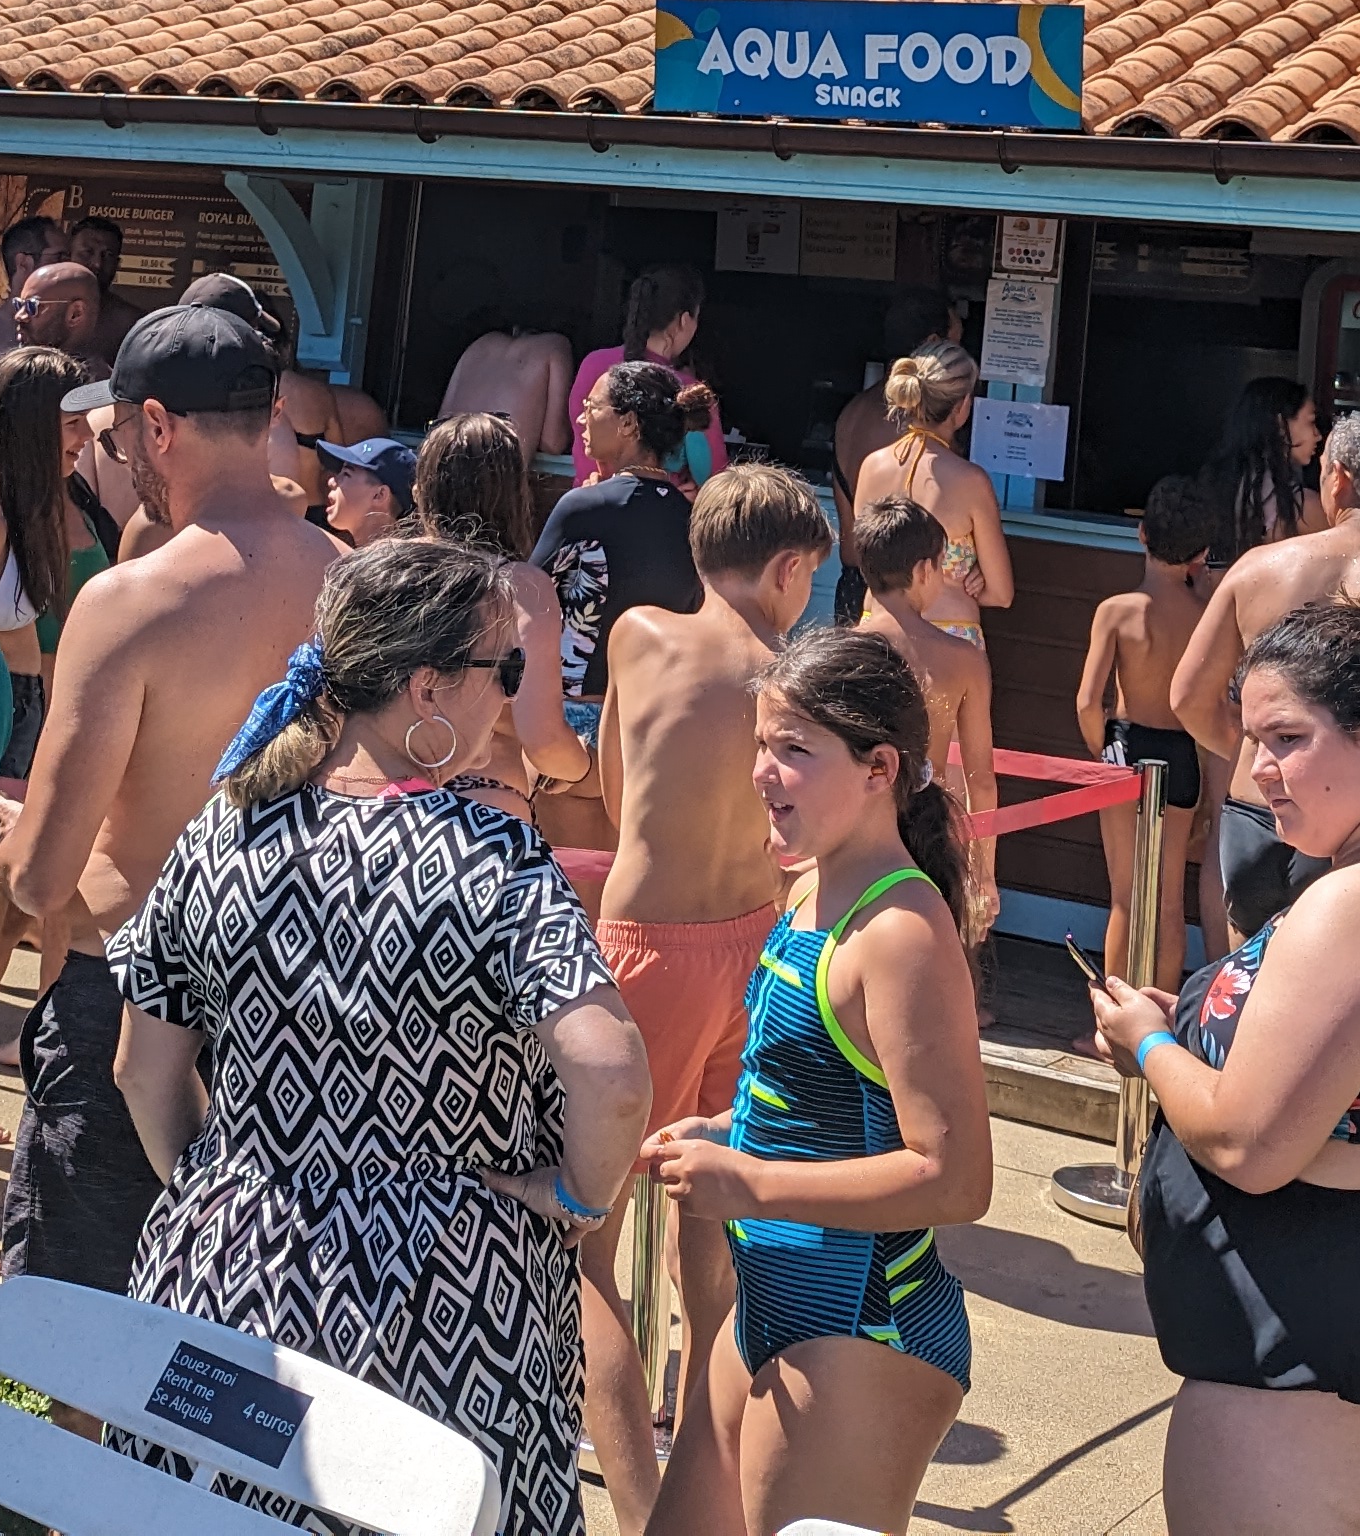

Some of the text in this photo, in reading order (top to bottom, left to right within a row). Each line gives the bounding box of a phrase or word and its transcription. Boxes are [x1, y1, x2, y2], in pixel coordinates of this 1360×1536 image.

[697, 26, 1031, 87] AQUA FOOD
[814, 83, 902, 109] SNACK
[89, 205, 174, 221] BASQUE BURGER
[198, 212, 256, 225] ROYAL BU
[163, 1368, 215, 1401] Rent me
[173, 1349, 239, 1387] Louez moi
[152, 1387, 214, 1424] Se Alquila
[242, 1402, 296, 1437] 4 euros
